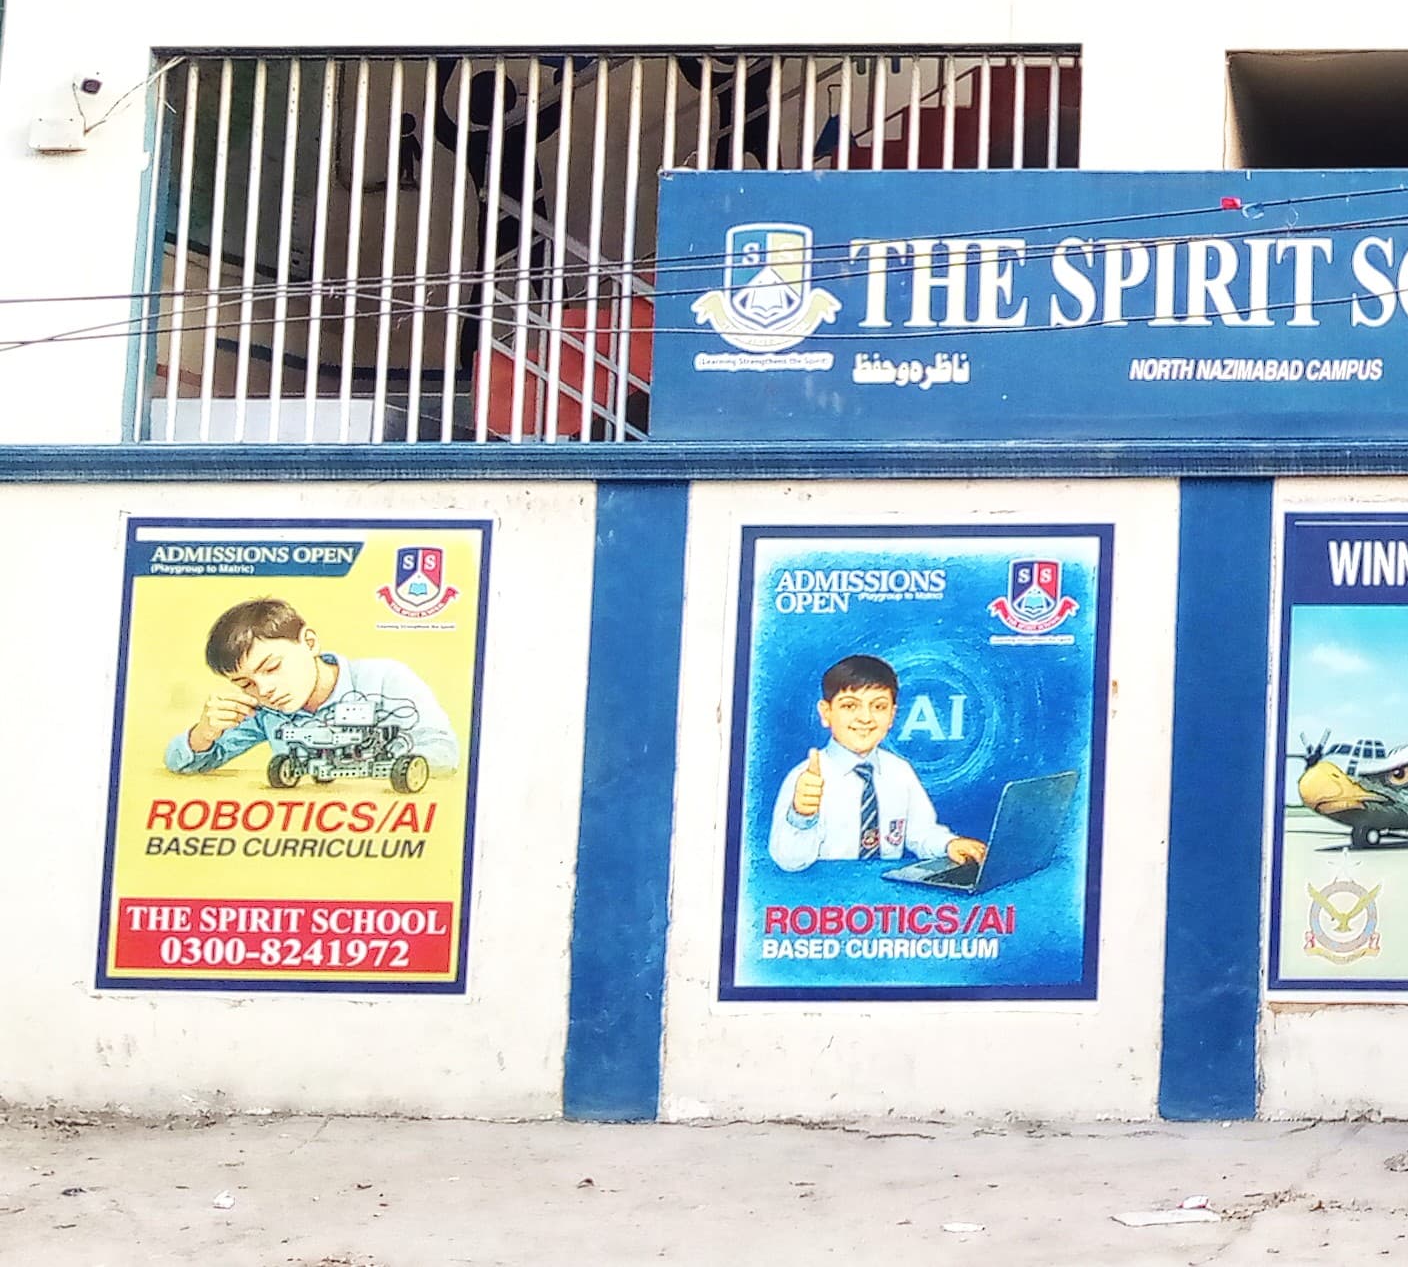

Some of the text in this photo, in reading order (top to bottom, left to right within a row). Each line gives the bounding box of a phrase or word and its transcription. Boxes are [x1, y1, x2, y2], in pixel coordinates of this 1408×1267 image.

[850, 237, 1029, 329] THE
[1050, 236, 1334, 329] SPIRIT
[1129, 358, 1384, 382] NORTH NAZIMABAD CAMPUS
[151, 545, 355, 564] ADMISSIONS OPEN
[774, 568, 947, 593] ADMISSIONS
[775, 592, 850, 615] OPEN
[898, 694, 966, 742] AI
[145, 798, 437, 834] ROBOTICS/AI
[145, 835, 425, 860] BASED CURRICULUM
[126, 904, 447, 936] THE SPIRIT SCHOOL
[764, 904, 1016, 935] ROBOTICS/AI
[160, 935, 410, 968] 0300-8241972
[762, 937, 998, 960] BASED CURRICULUM
